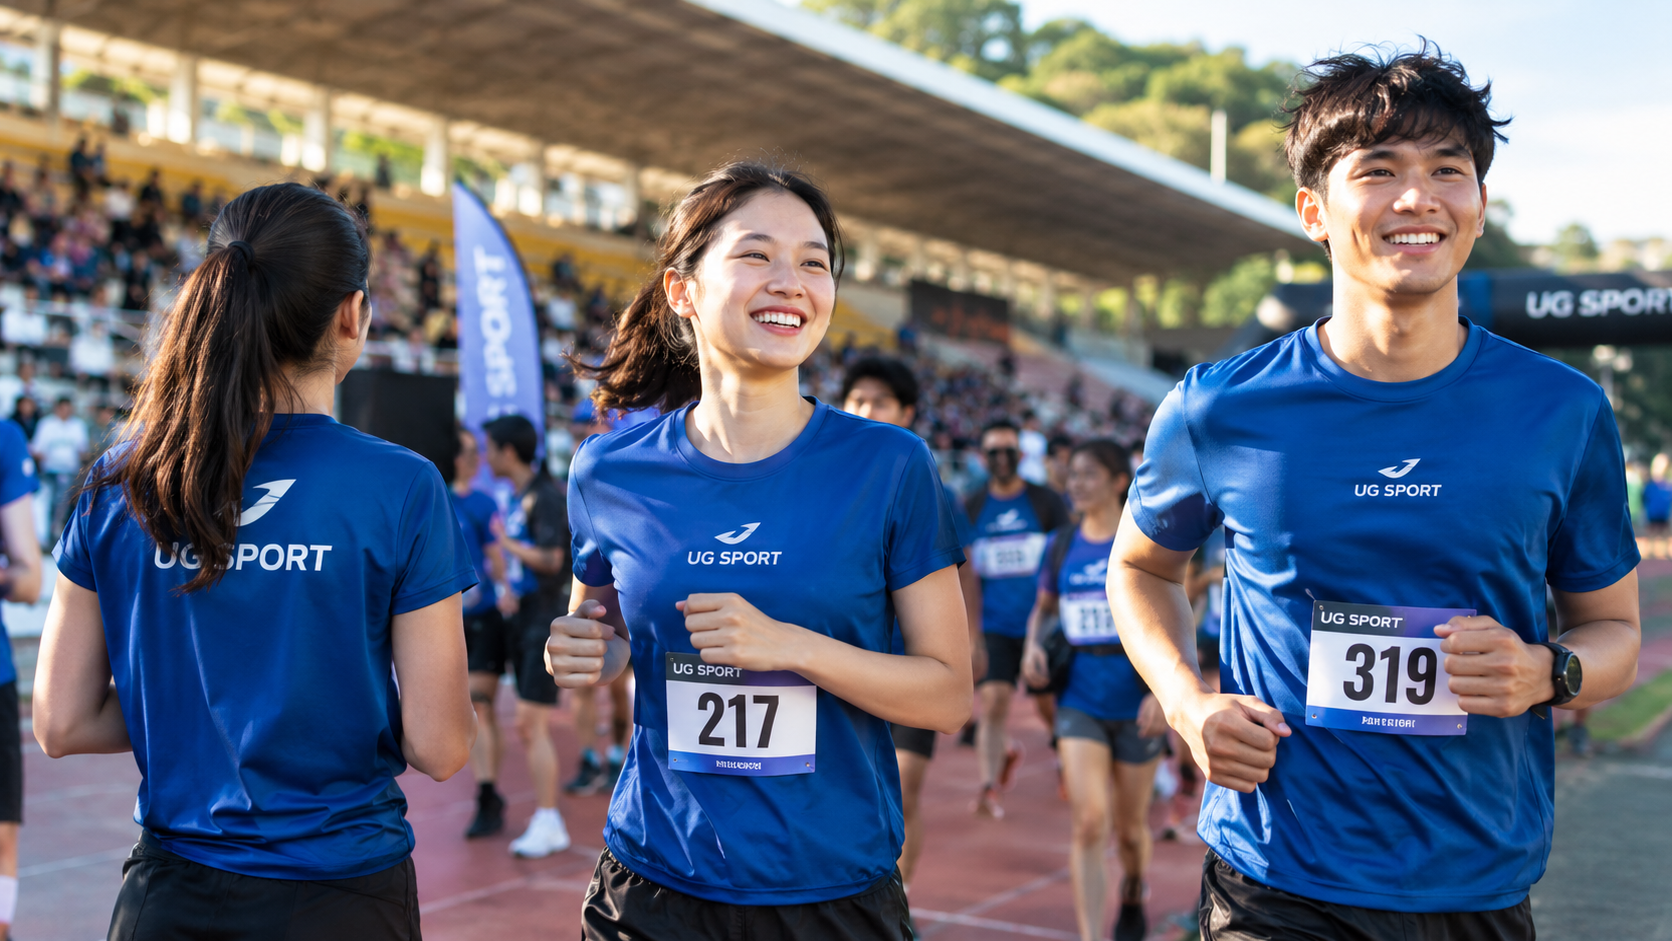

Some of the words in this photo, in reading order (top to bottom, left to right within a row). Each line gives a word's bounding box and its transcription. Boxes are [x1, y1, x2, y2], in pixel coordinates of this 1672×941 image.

[1525, 290, 1574, 318] UG
[1578, 288, 1672, 317] SPOR
[474, 245, 517, 397] SPORT
[1354, 484, 1379, 497] UG
[1384, 484, 1442, 497] SPORT
[687, 551, 714, 565] UG
[719, 551, 782, 565] SPORT
[1320, 611, 1345, 625] UG
[1348, 614, 1403, 628] SPORT
[673, 662, 694, 675] UG
[697, 664, 742, 678] SPORT
[1343, 643, 1437, 705] 319
[697, 692, 779, 748] 217
